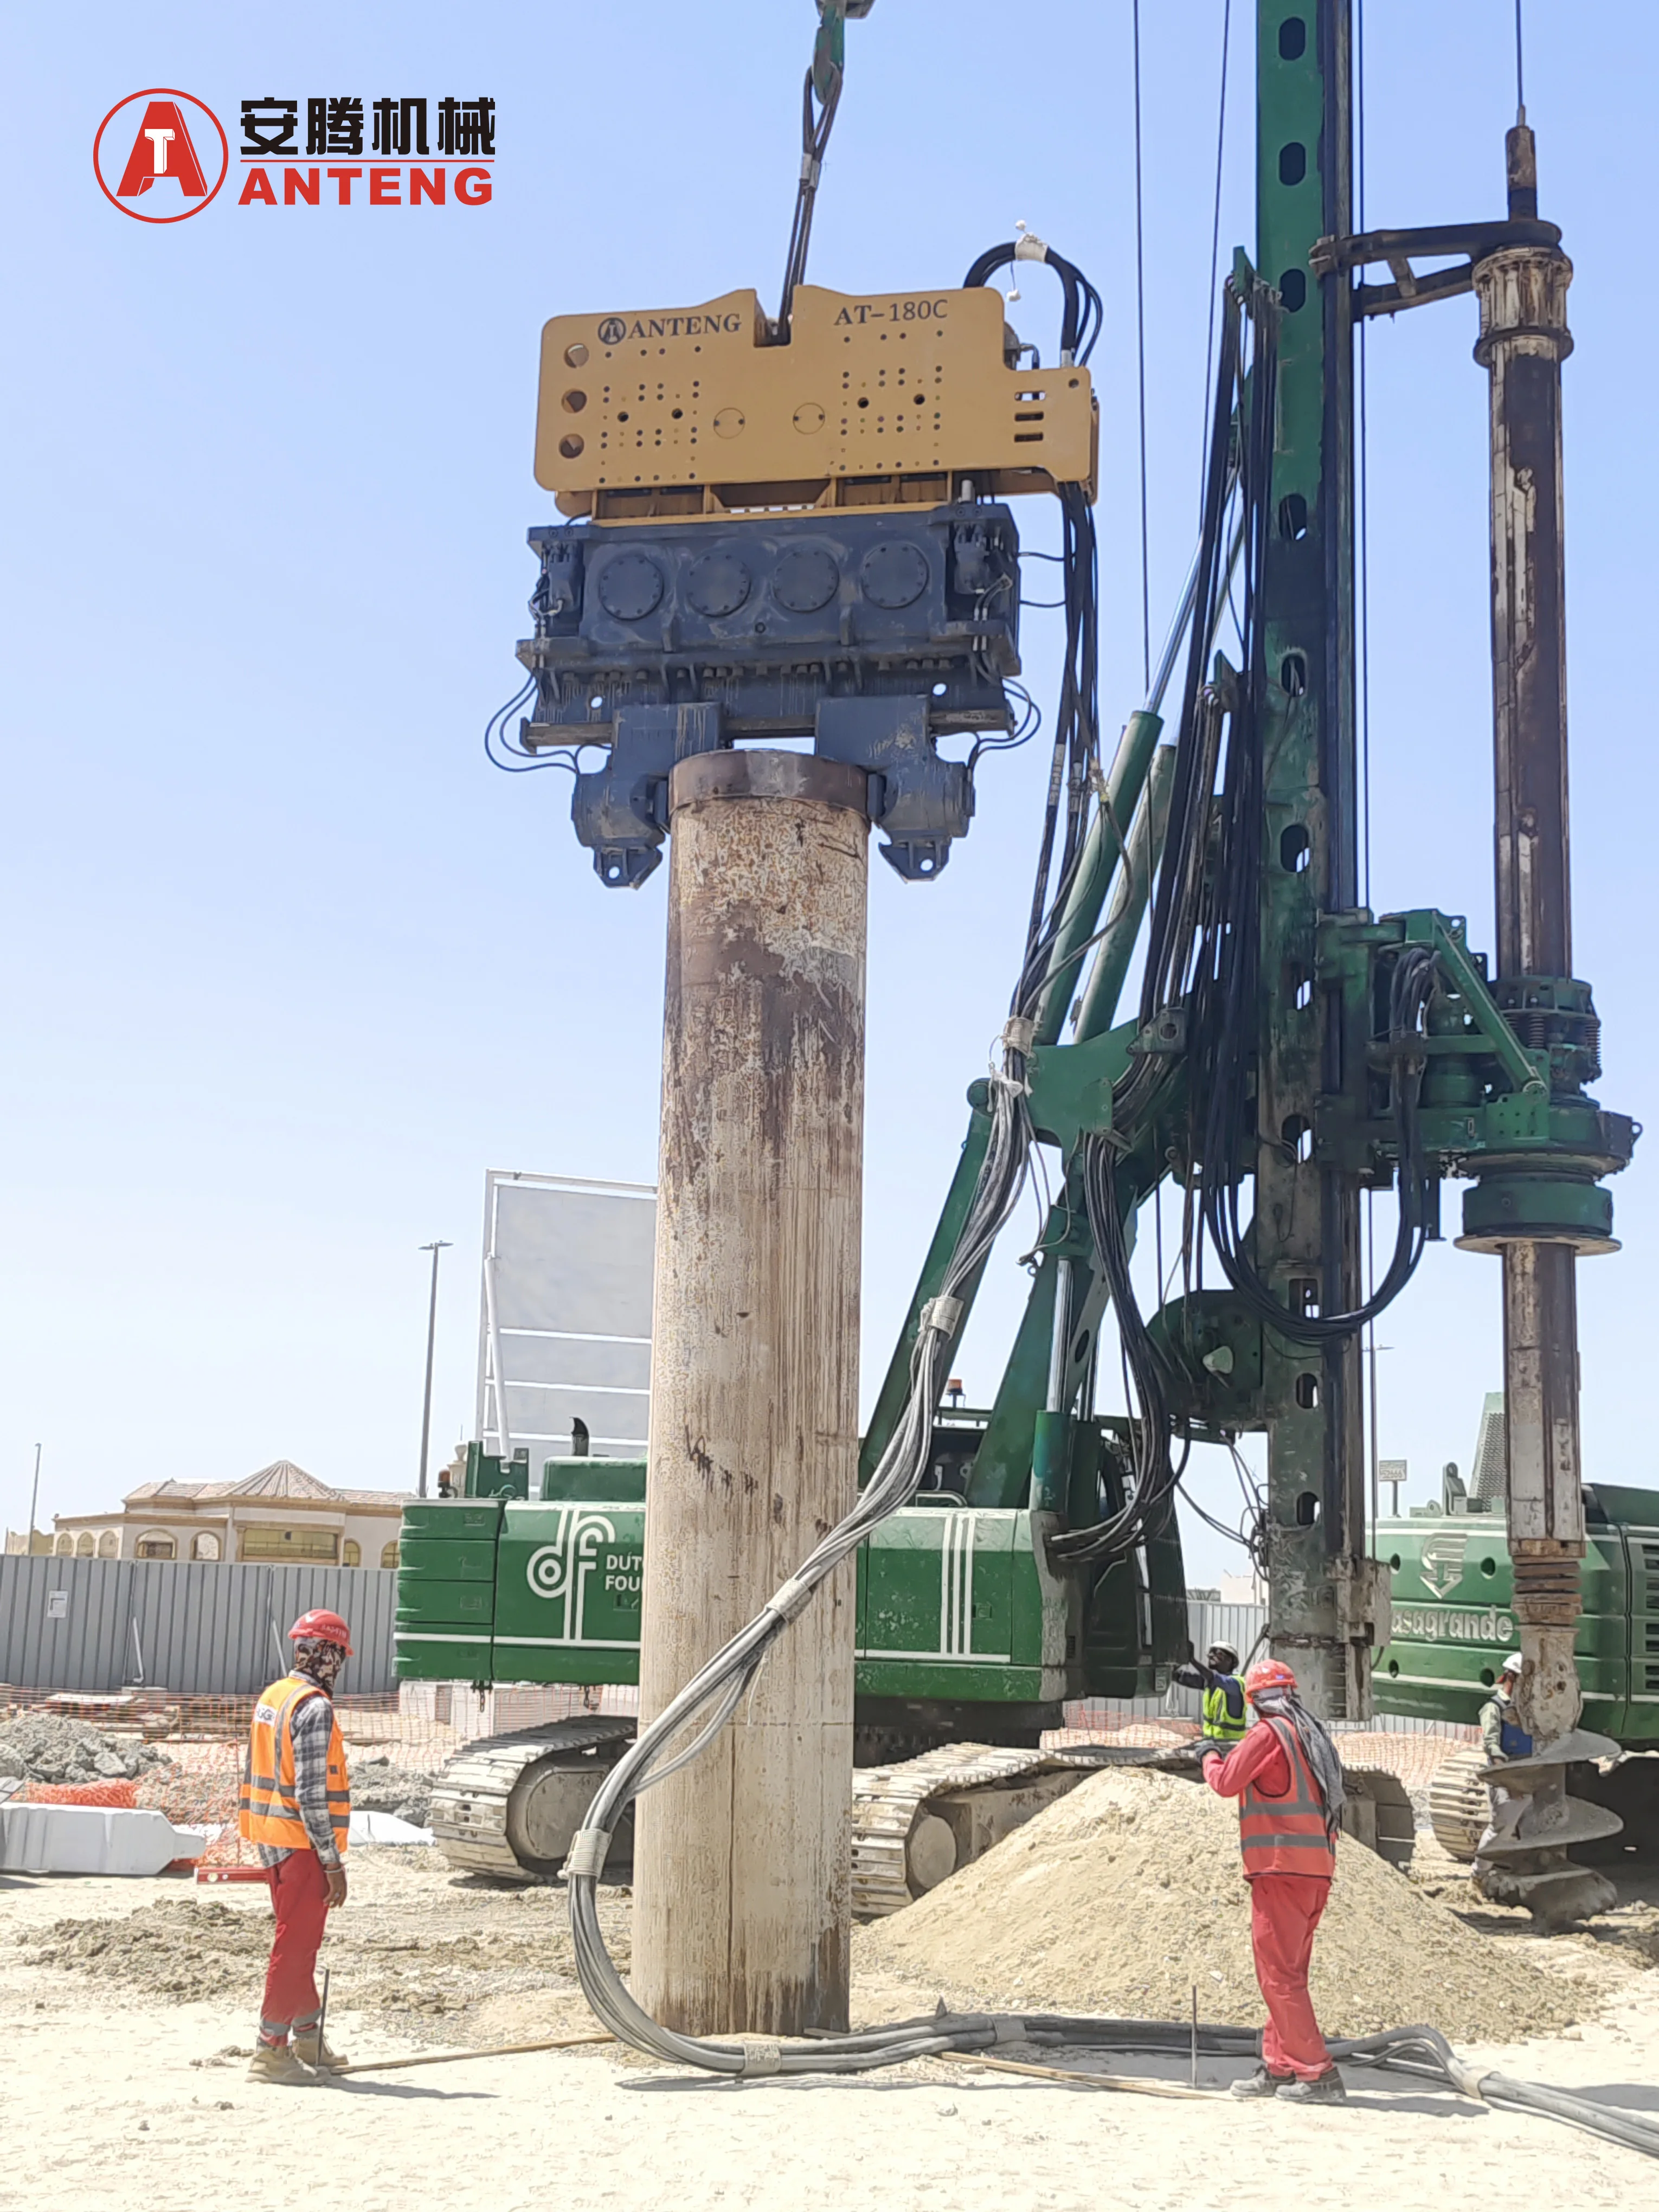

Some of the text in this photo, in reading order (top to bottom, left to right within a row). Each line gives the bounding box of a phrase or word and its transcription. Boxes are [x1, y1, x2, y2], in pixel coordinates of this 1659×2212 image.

[833, 299, 948, 325] AT-180C
[627, 313, 742, 339] ANTENG
[606, 1554, 644, 1572] DUT
[605, 1574, 642, 1592] FOU
[1391, 1604, 1514, 1642] asagrande
